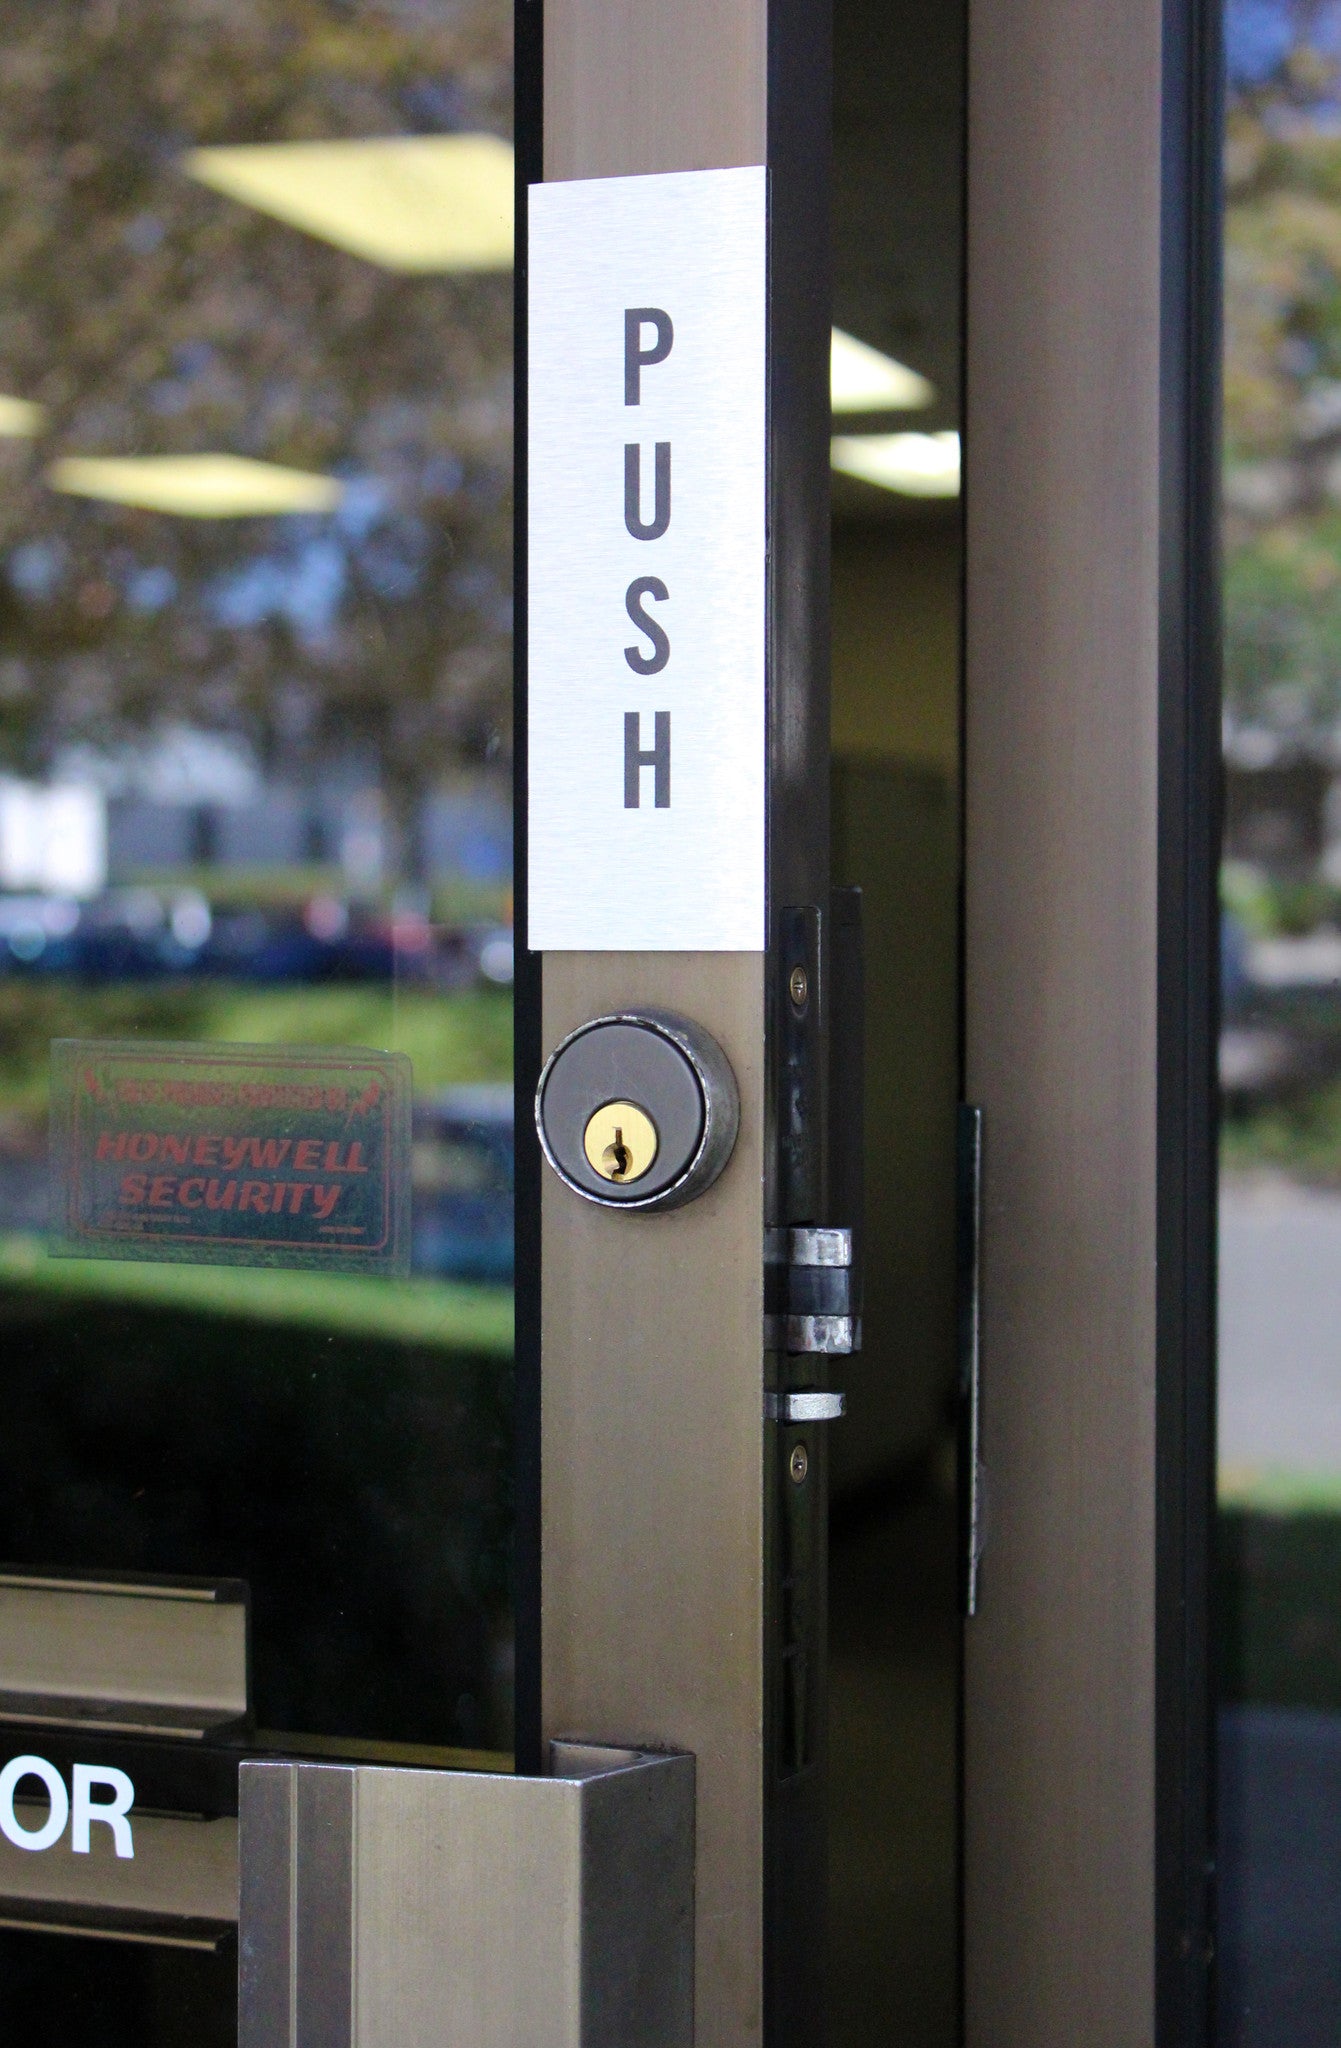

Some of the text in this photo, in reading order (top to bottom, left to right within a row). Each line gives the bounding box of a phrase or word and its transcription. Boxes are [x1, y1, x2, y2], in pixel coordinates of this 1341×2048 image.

[624, 307, 674, 809] PUSH
[95, 1131, 369, 1174] HONEYWELL
[119, 1173, 341, 1219] SECURITY
